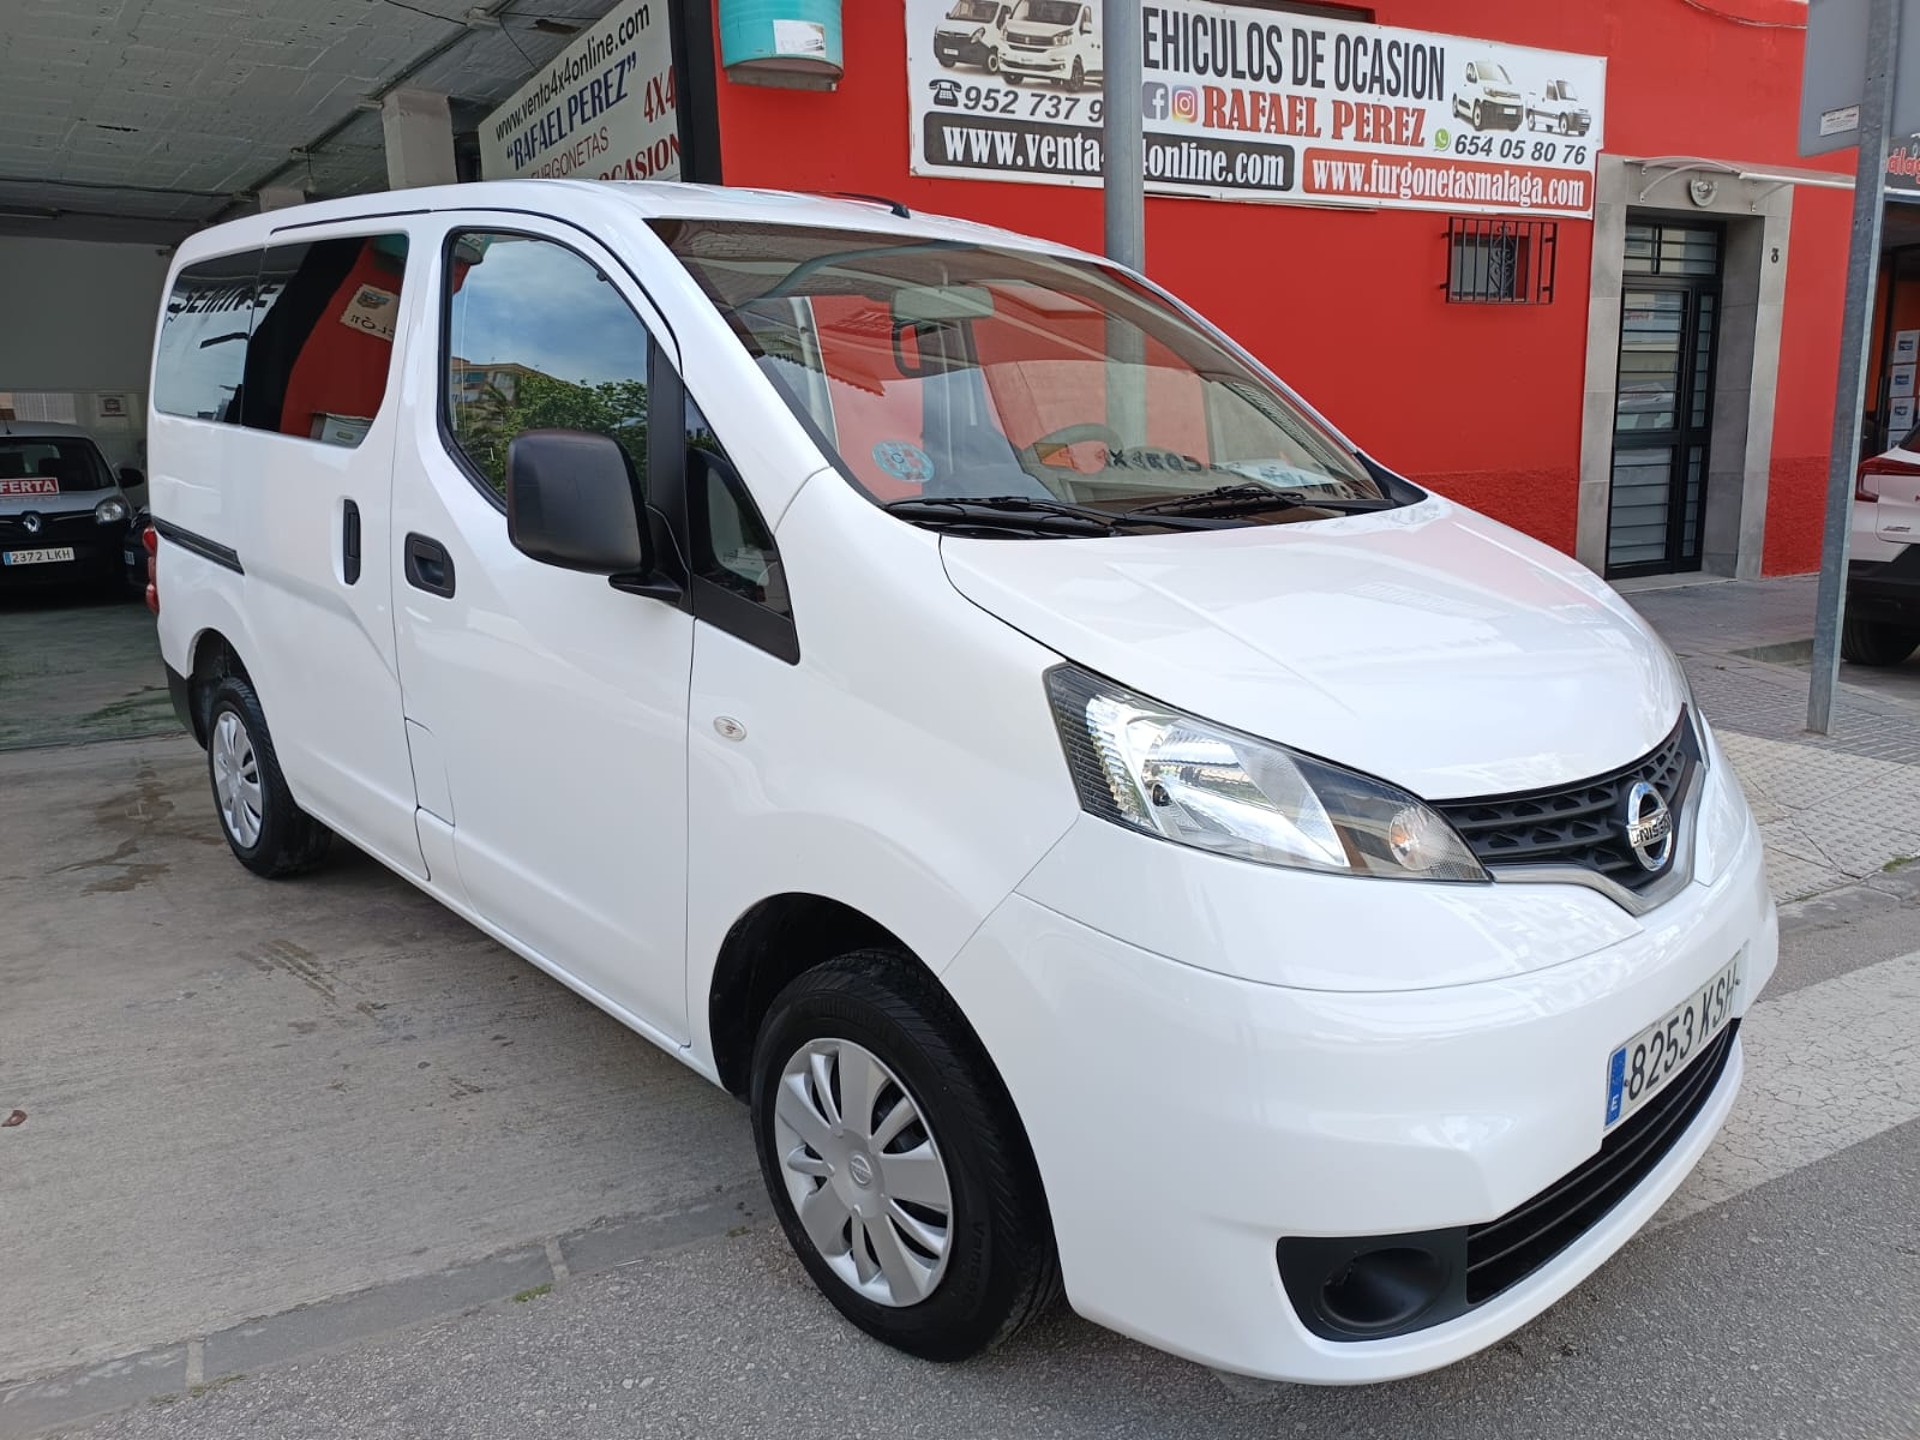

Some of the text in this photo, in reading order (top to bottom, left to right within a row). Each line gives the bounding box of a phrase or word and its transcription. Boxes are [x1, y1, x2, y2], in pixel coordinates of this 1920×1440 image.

[1143, 8, 1446, 102] EHICULOS DE OCASION
[531, 65, 677, 178] RGONETAS 4X4
[963, 86, 1019, 115] 952
[1028, 93, 1081, 121] 737
[1202, 84, 1427, 148] RAFAEL PEREZ
[942, 125, 1285, 187] www.ventaonline.com
[1454, 133, 1587, 165] 654 05 80 76
[1311, 158, 1585, 208] www.furgonetasmalaga.com
[0, 480, 56, 493] FERTA
[1628, 962, 1737, 1101] 8253 KSH
